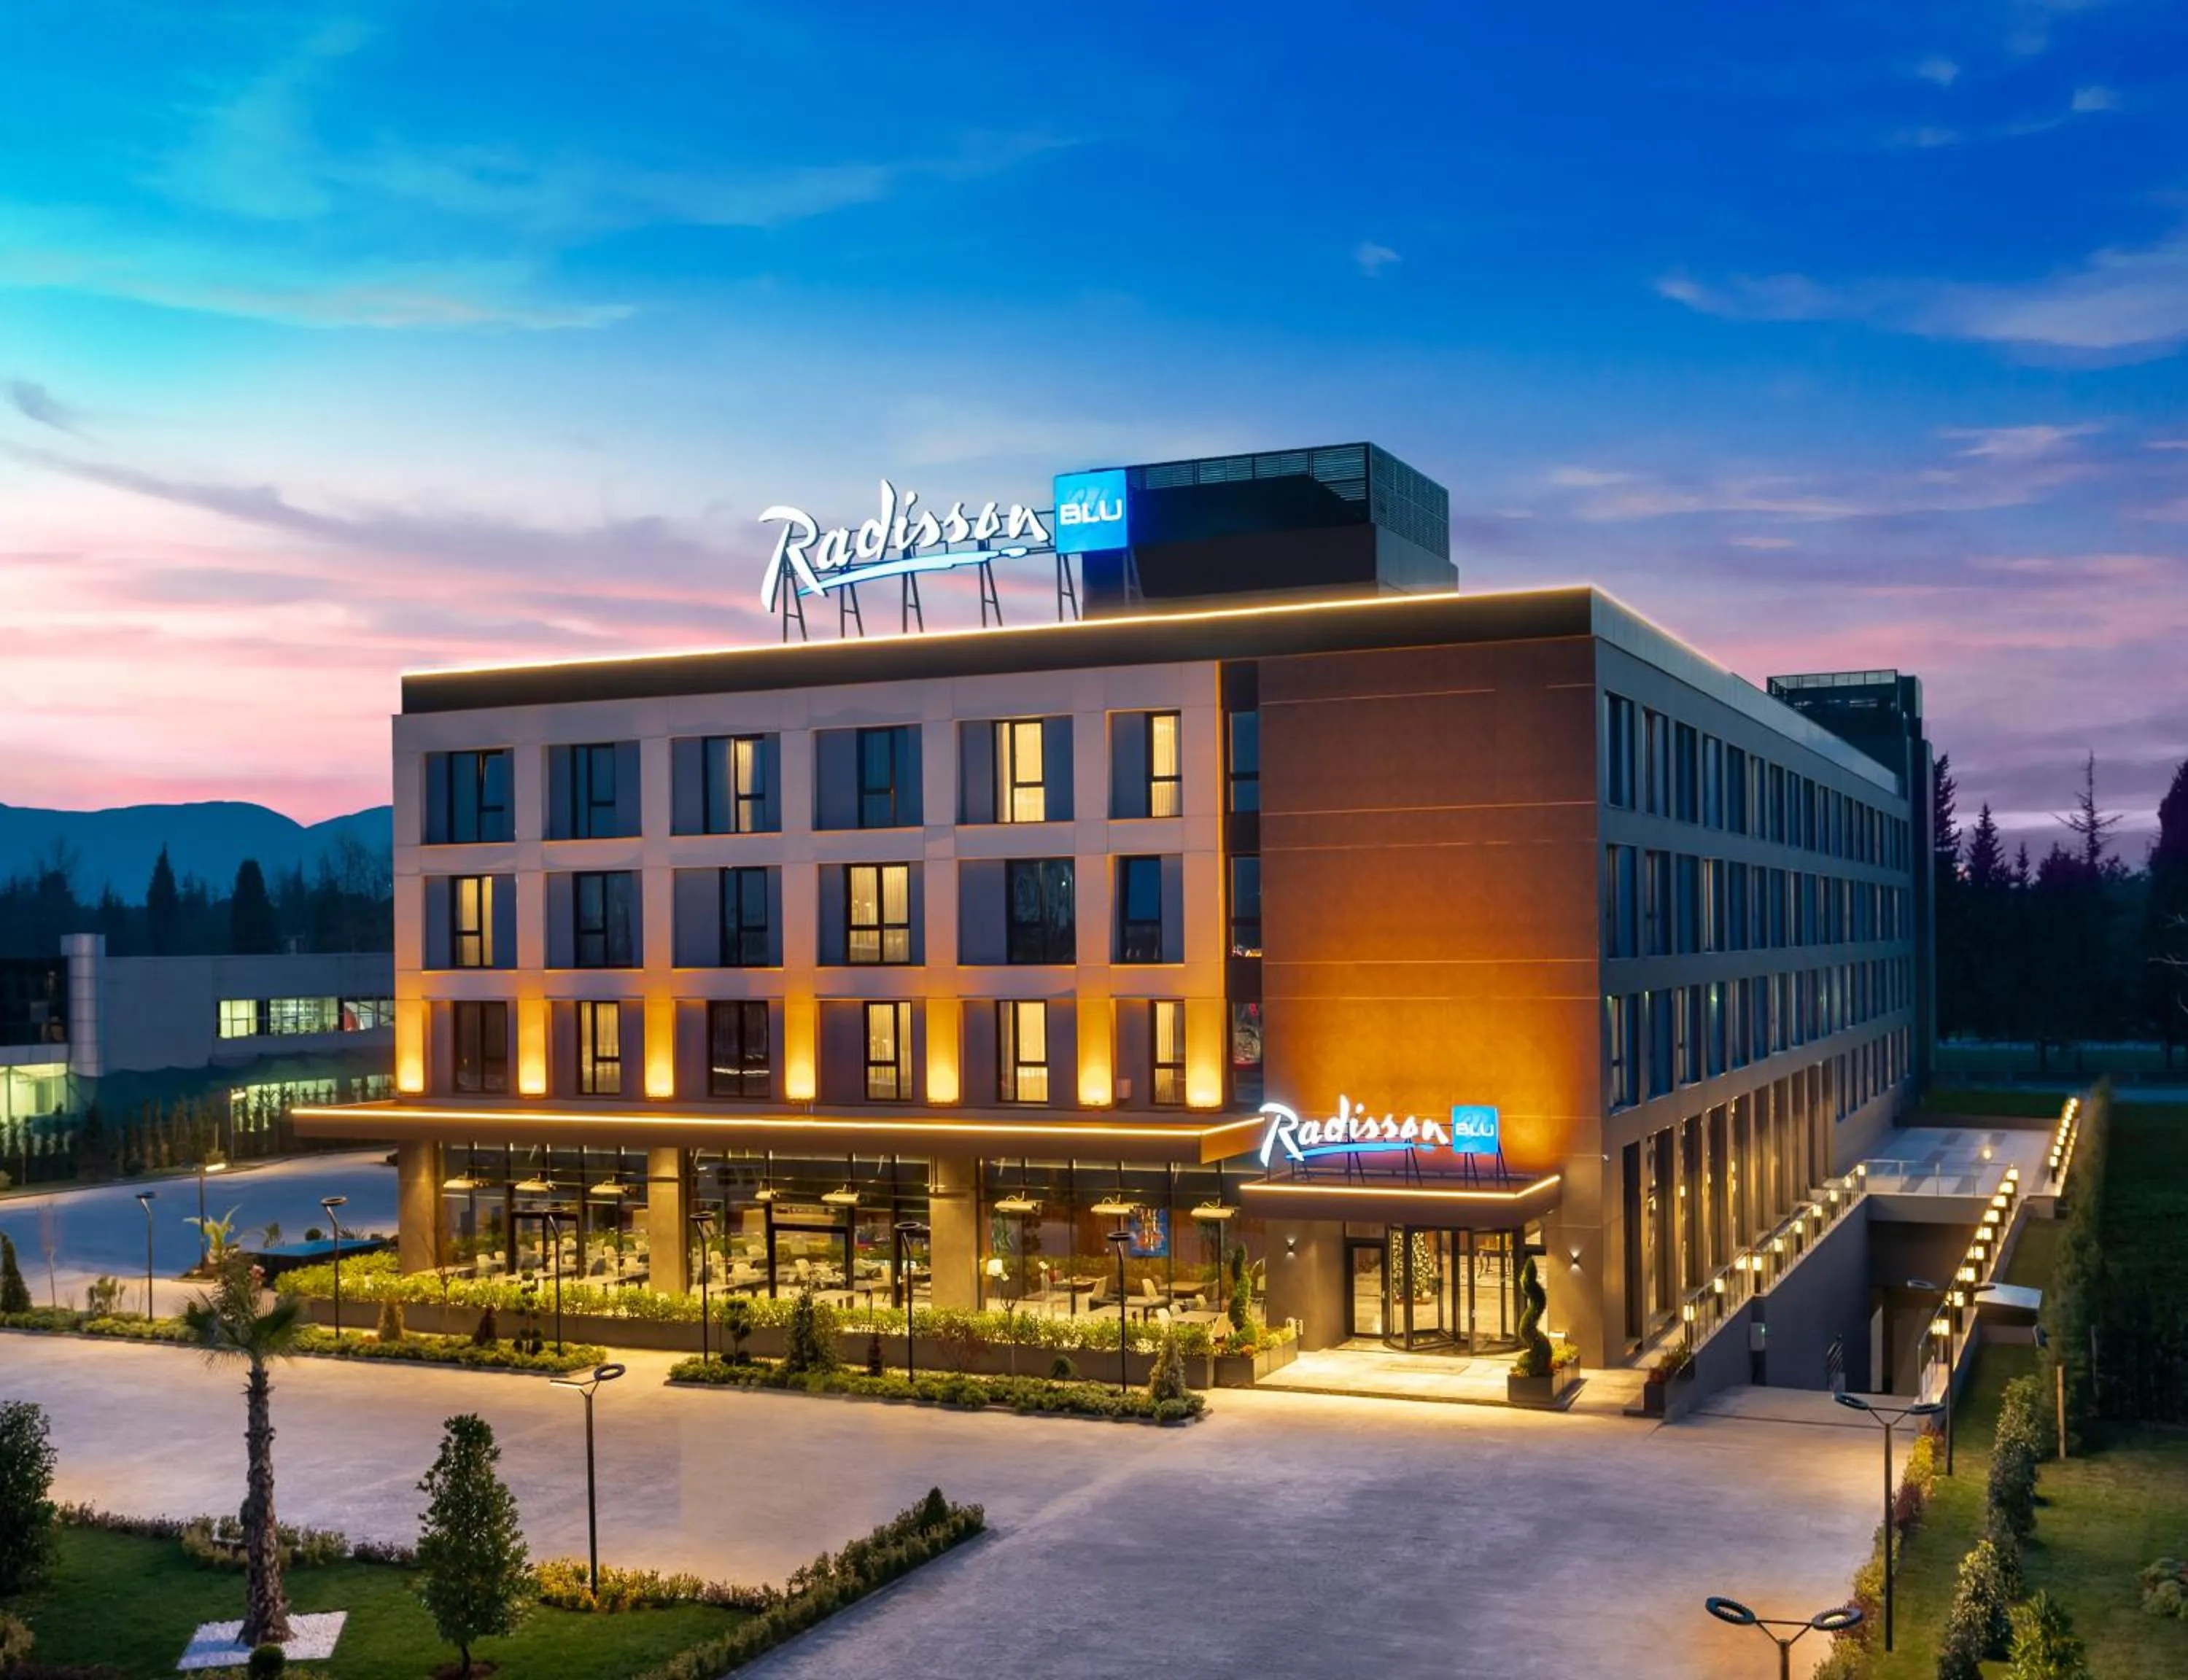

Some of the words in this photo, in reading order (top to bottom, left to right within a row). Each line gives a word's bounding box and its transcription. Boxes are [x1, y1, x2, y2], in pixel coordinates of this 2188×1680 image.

[759, 478, 1050, 614] Radisson
[1060, 498, 1122, 525] BLU
[1259, 1094, 1450, 1167] Radisson
[1455, 1121, 1494, 1137] BLU
